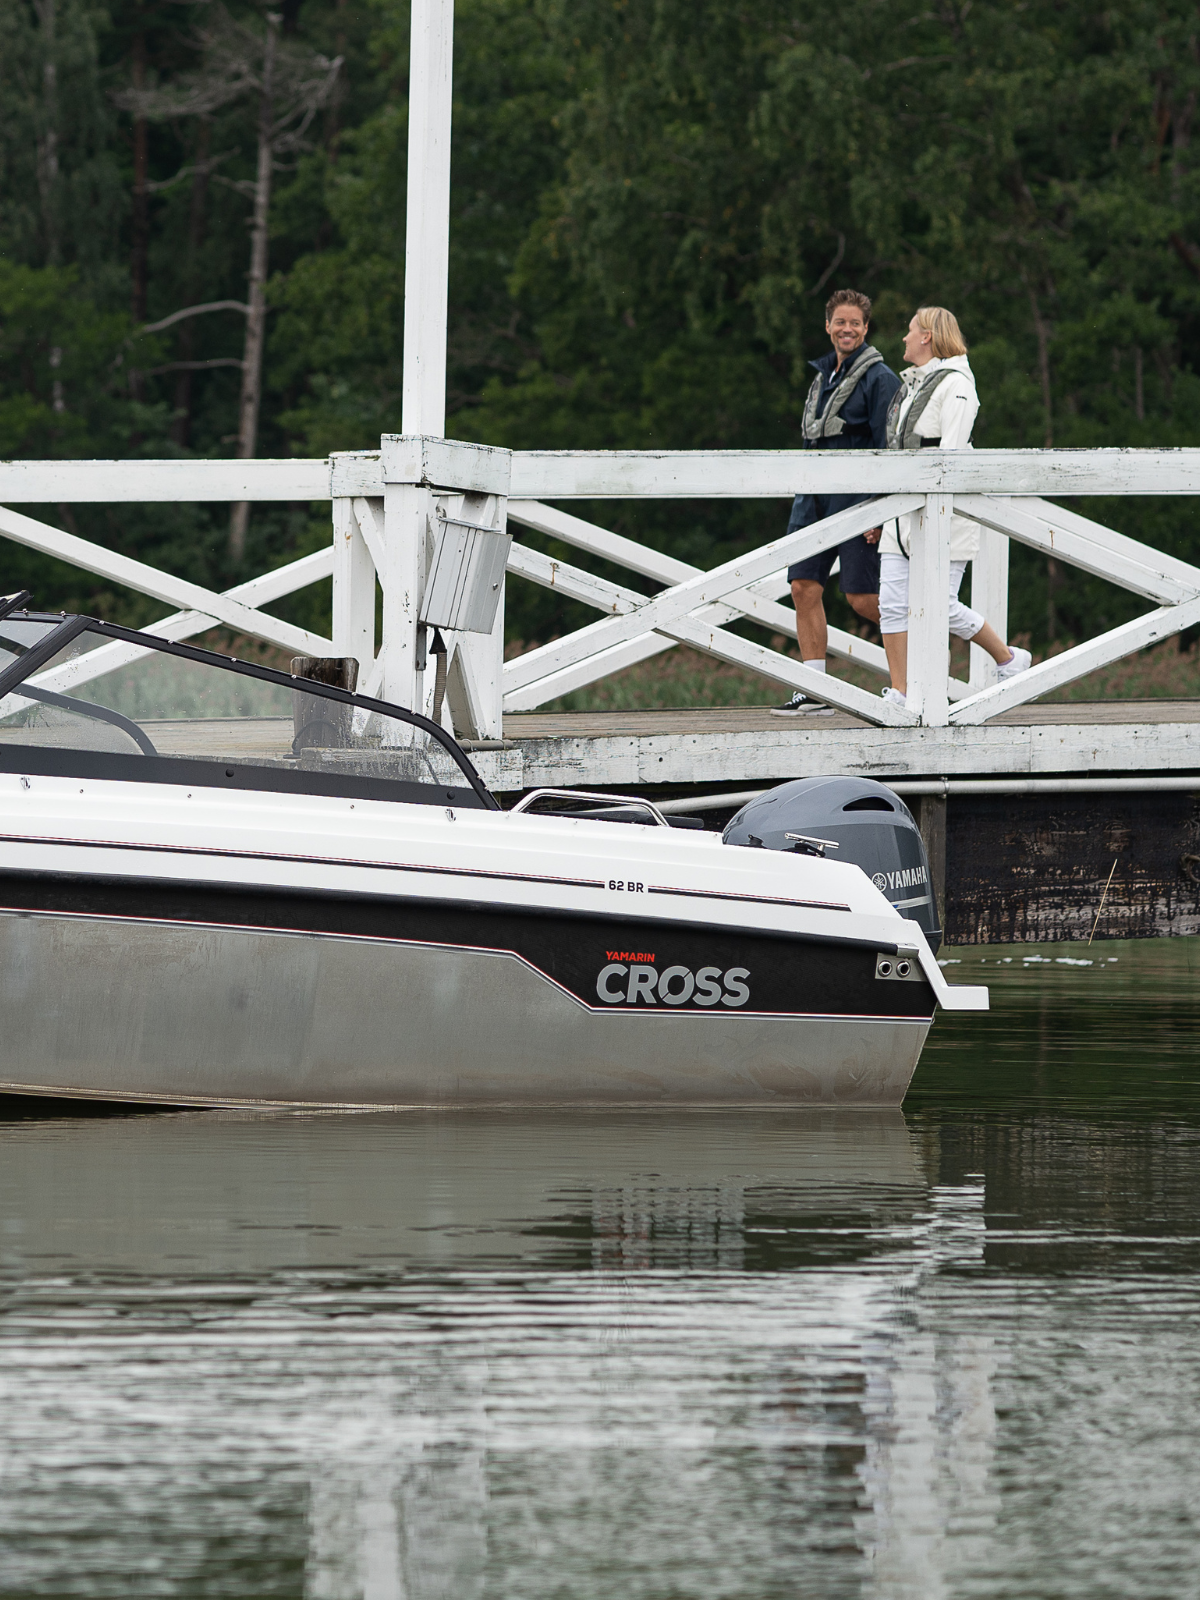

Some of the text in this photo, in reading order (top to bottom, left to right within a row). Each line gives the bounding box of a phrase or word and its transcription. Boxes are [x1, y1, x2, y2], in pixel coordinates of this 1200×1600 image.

[608, 880, 644, 893] 62 BR
[886, 865, 928, 890] YAMAHA
[605, 950, 656, 963] YAMARIN
[596, 963, 751, 1007] CROSS
